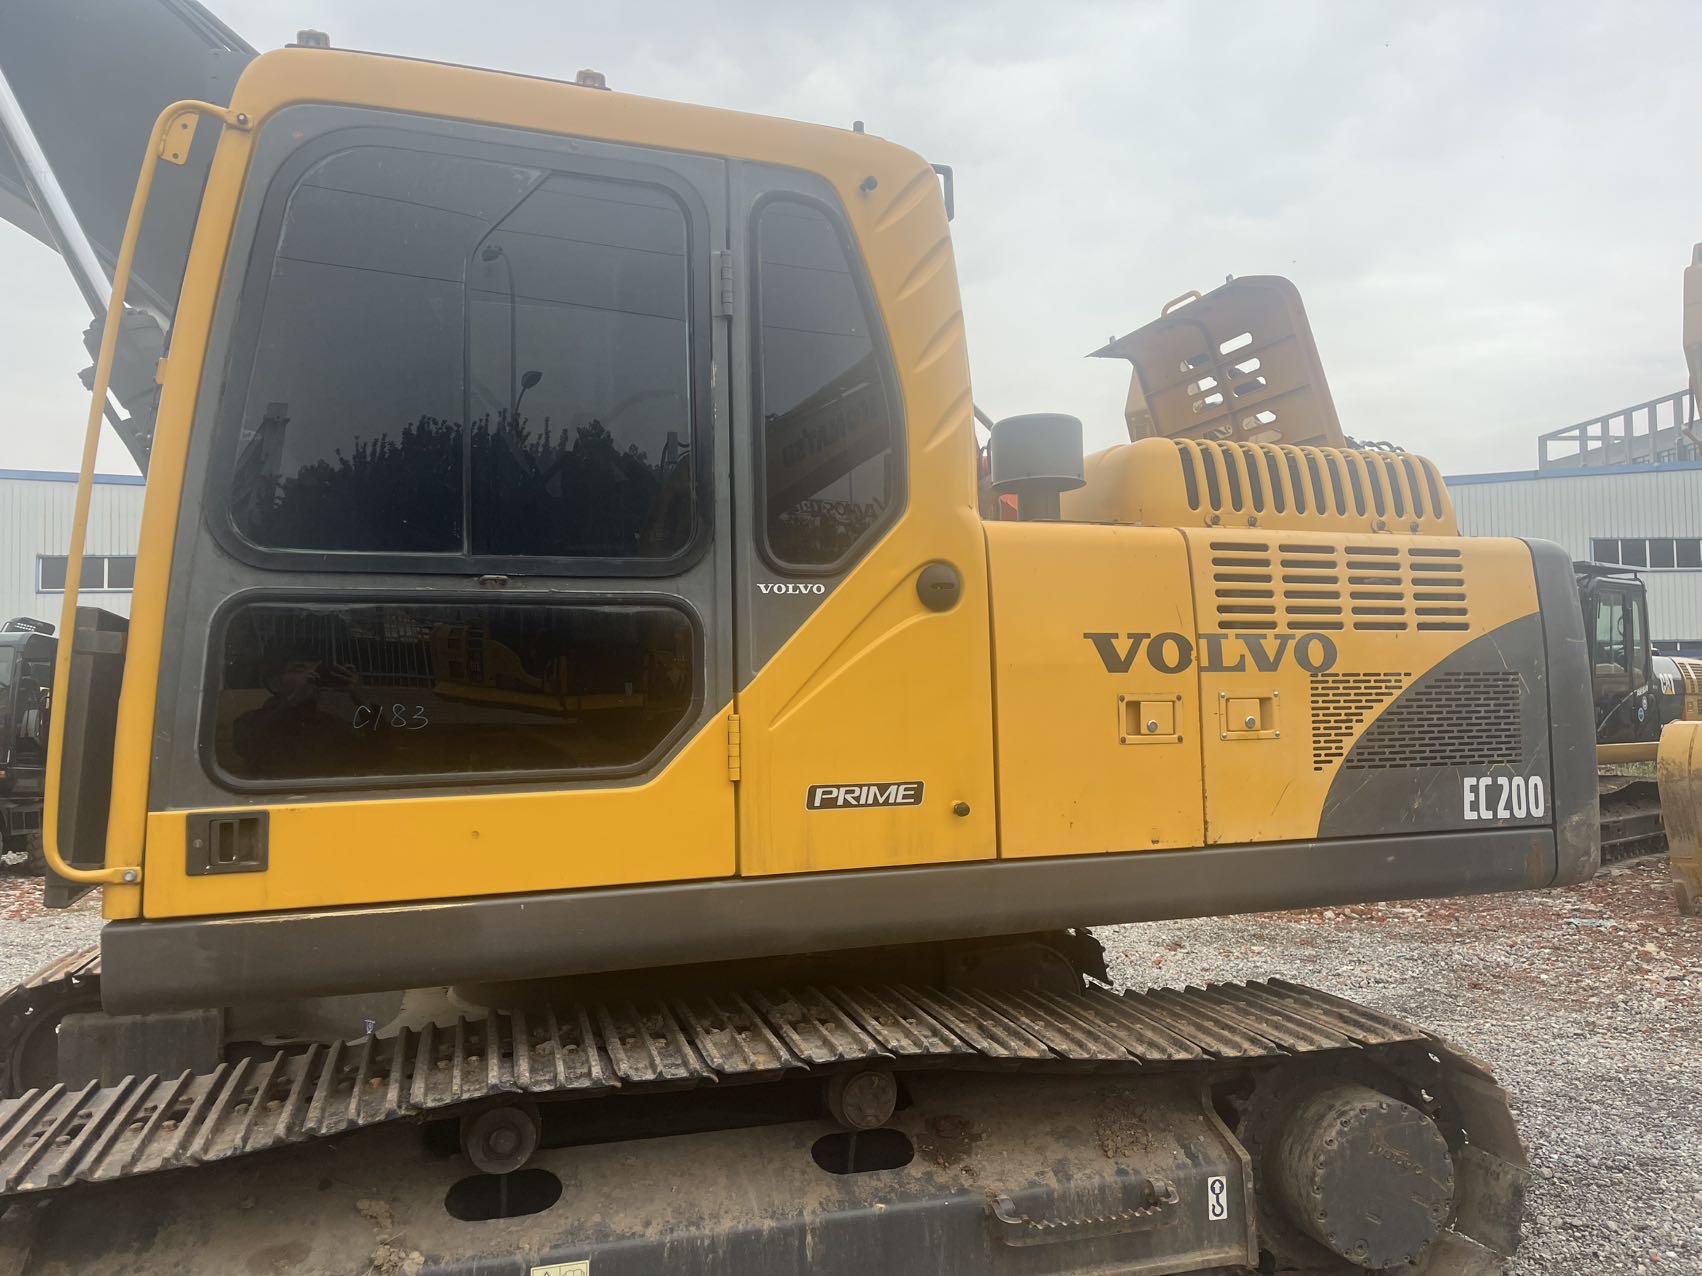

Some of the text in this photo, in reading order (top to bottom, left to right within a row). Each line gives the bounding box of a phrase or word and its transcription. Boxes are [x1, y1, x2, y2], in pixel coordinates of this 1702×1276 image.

[756, 583, 826, 595] VOLVO
[1083, 632, 1338, 675] VOLVO
[813, 784, 918, 807] PRIME
[1463, 775, 1545, 820] EC200
